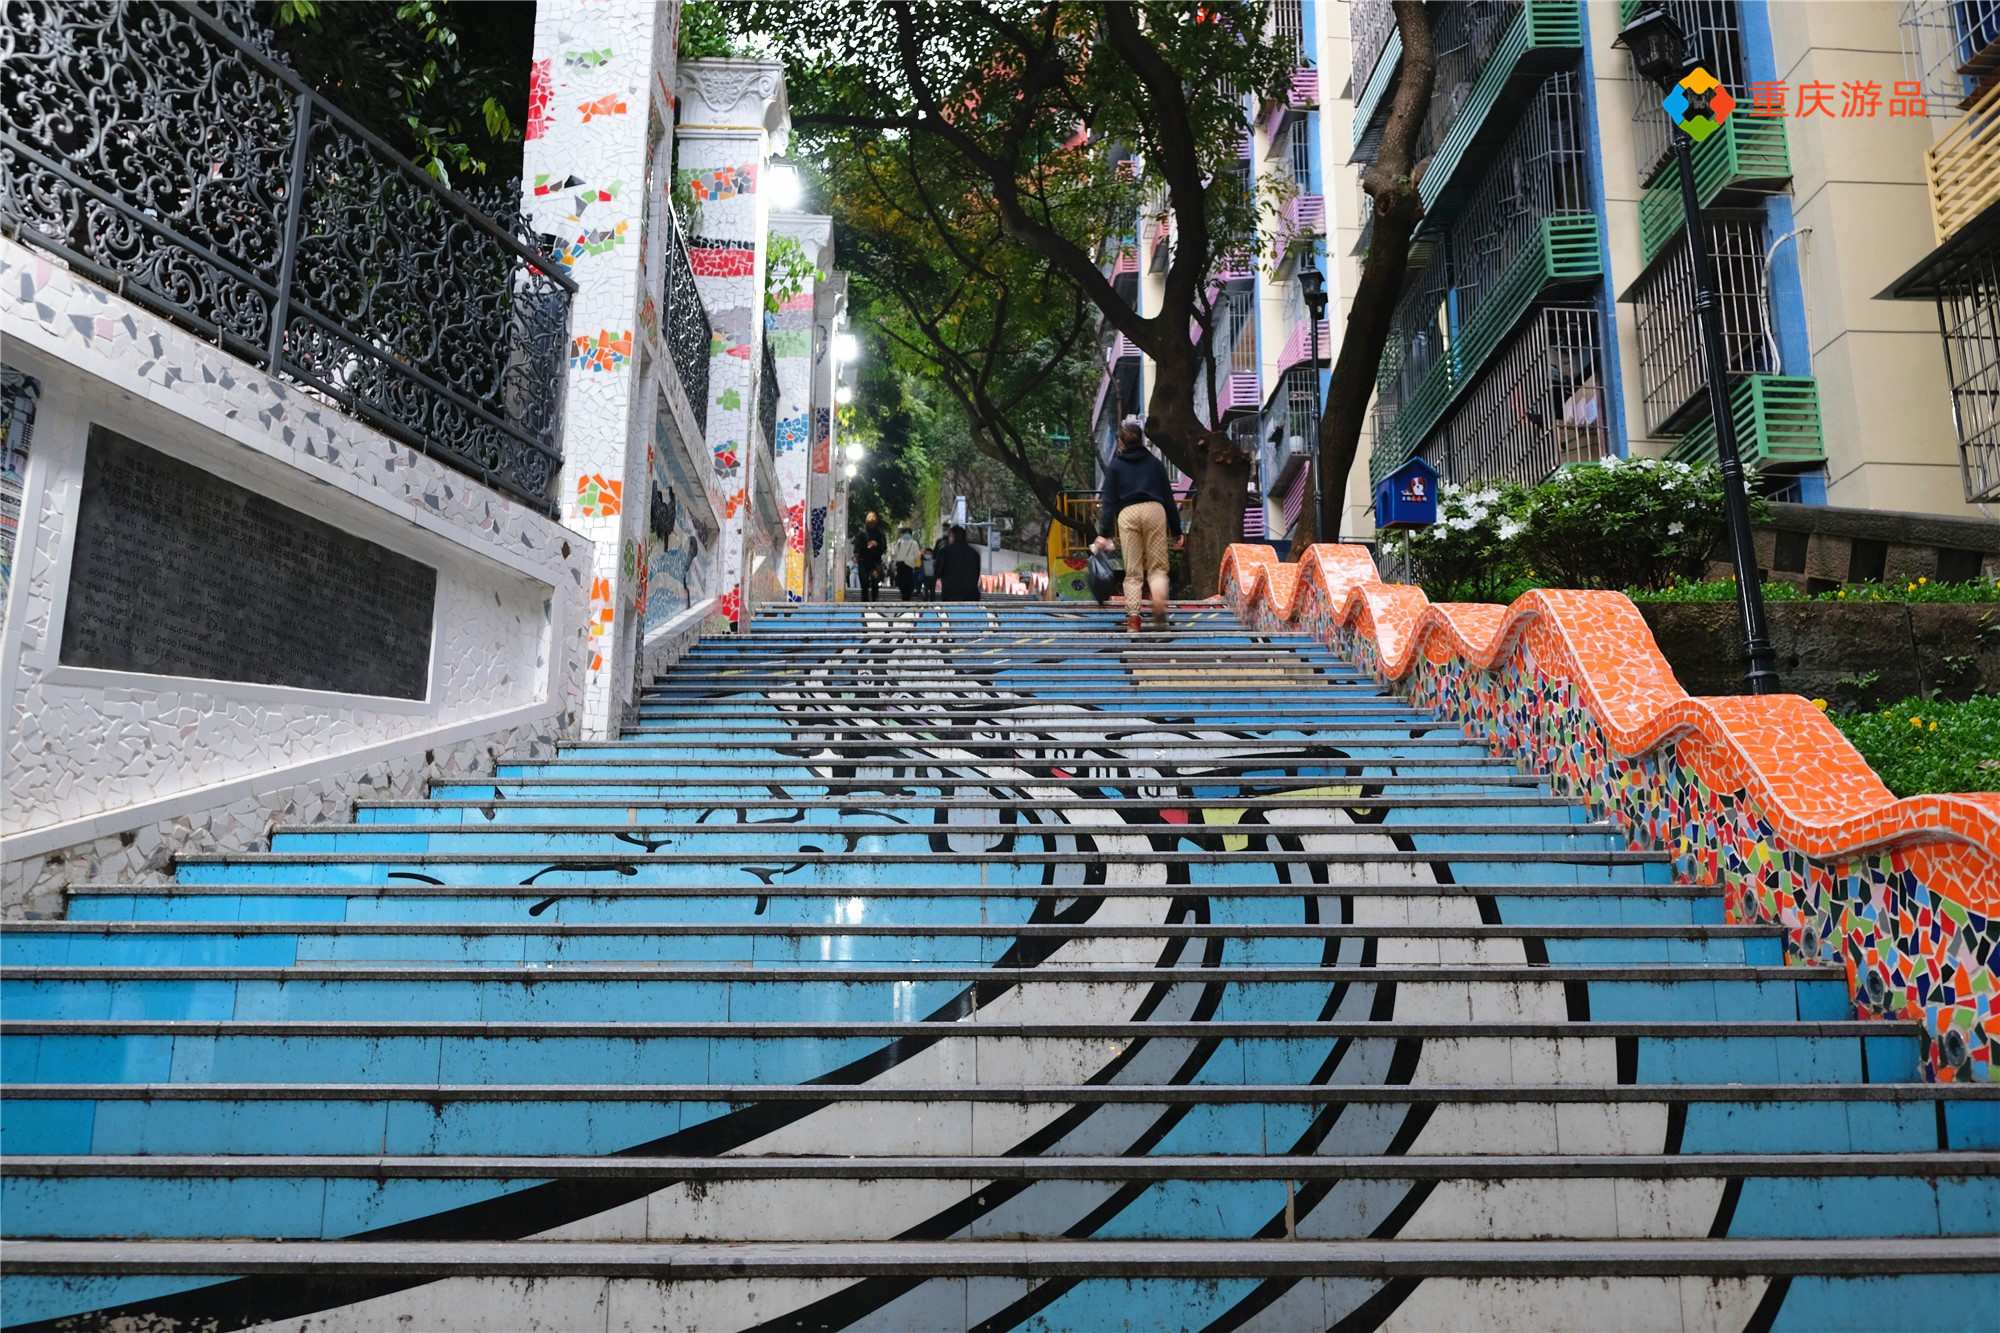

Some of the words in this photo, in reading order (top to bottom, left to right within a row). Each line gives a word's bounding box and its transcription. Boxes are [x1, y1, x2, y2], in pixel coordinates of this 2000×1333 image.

[90, 534, 114, 553] past
[224, 583, 235, 596] by
[237, 588, 257, 604] high
[103, 523, 149, 550] paradise
[151, 543, 164, 554] on
[167, 547, 193, 565] earth
[197, 558, 207, 570] in
[211, 563, 226, 577] the
[129, 563, 140, 575] of
[141, 523, 157, 537] the
[159, 530, 201, 553] mushroom
[203, 546, 233, 567] growth
[235, 559, 245, 570] of
[249, 564, 263, 577] the
[266, 570, 283, 584] real
[78, 625, 97, 638] see
[111, 634, 139, 653] happy
[173, 655, 185, 665] on
[80, 609, 120, 630] crowded
[251, 663, 266, 675] You
[268, 670, 283, 680] can
[83, 594, 101, 609] the
[215, 637, 226, 648] at
[271, 655, 285, 667] the
[140, 597, 155, 611] The
[189, 614, 200, 625] of
[231, 628, 242, 639] of
[342, 667, 352, 675] on
[177, 595, 193, 608] The
[351, 655, 369, 668] been
